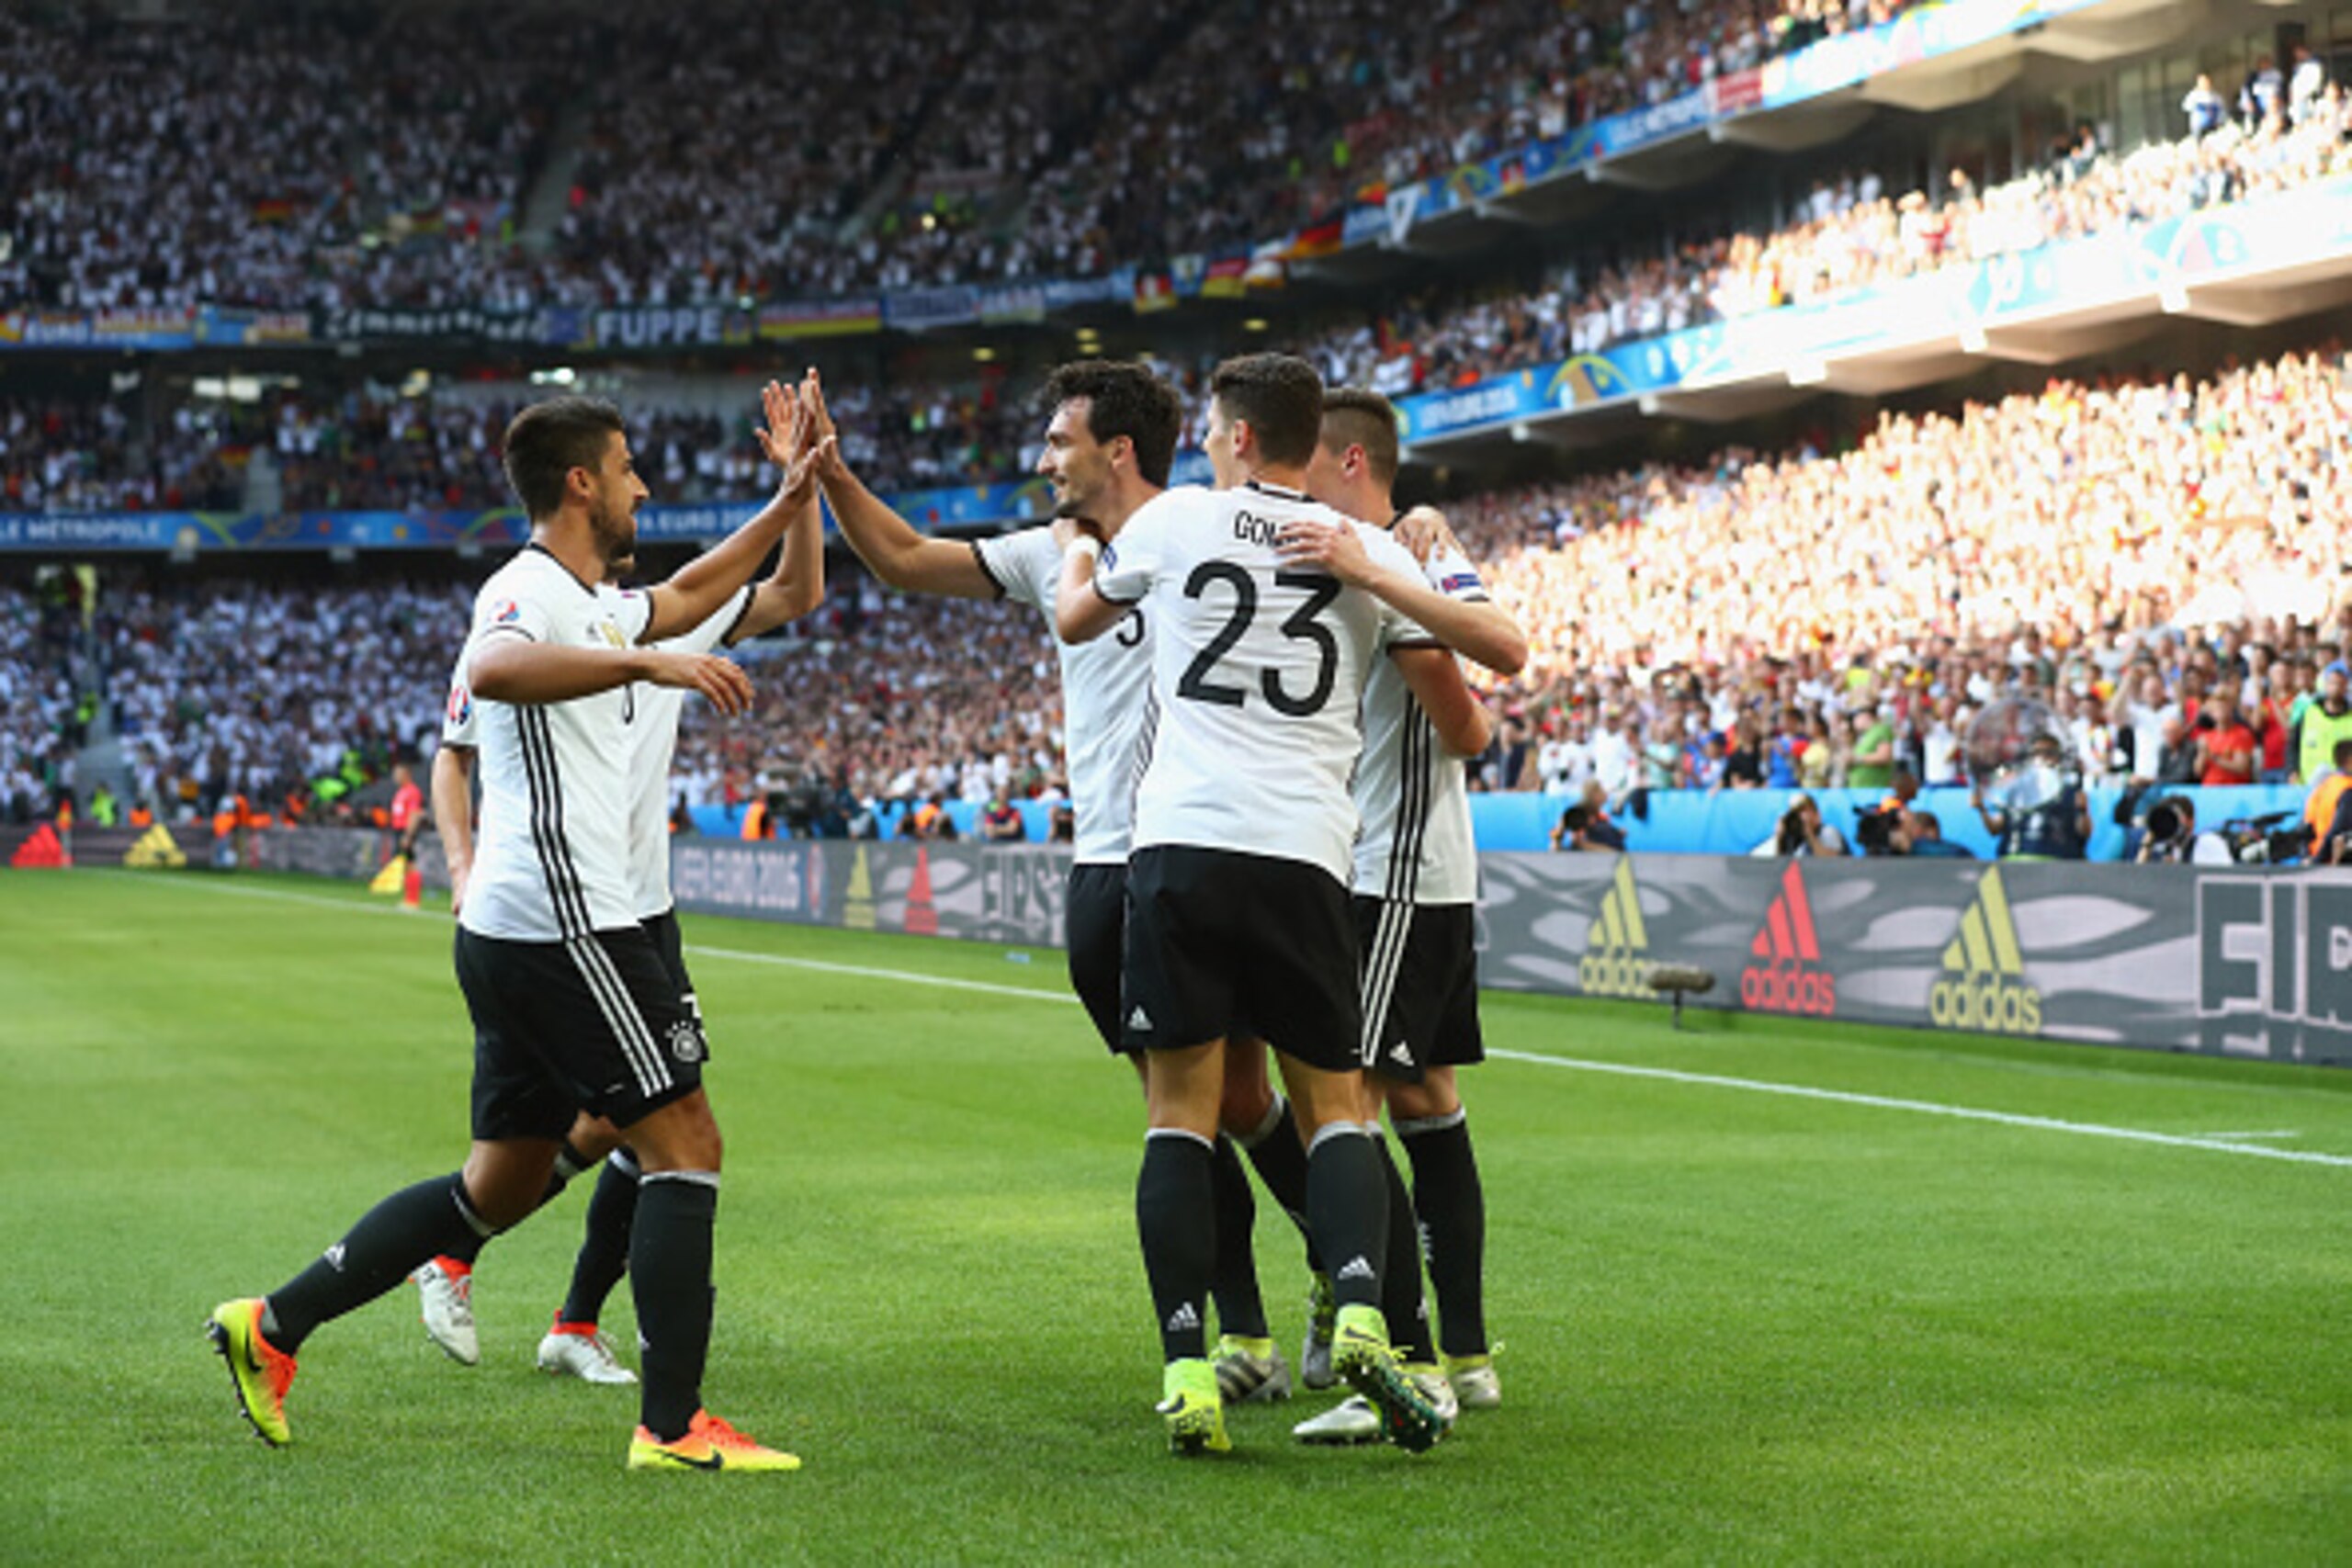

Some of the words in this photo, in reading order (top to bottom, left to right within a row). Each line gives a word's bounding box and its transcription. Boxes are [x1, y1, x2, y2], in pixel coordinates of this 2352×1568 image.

[596, 307, 722, 348] FUPPE
[1176, 559, 1343, 717] 23
[1741, 960, 1835, 1017] adidas
[1931, 974, 2041, 1035] adidas
